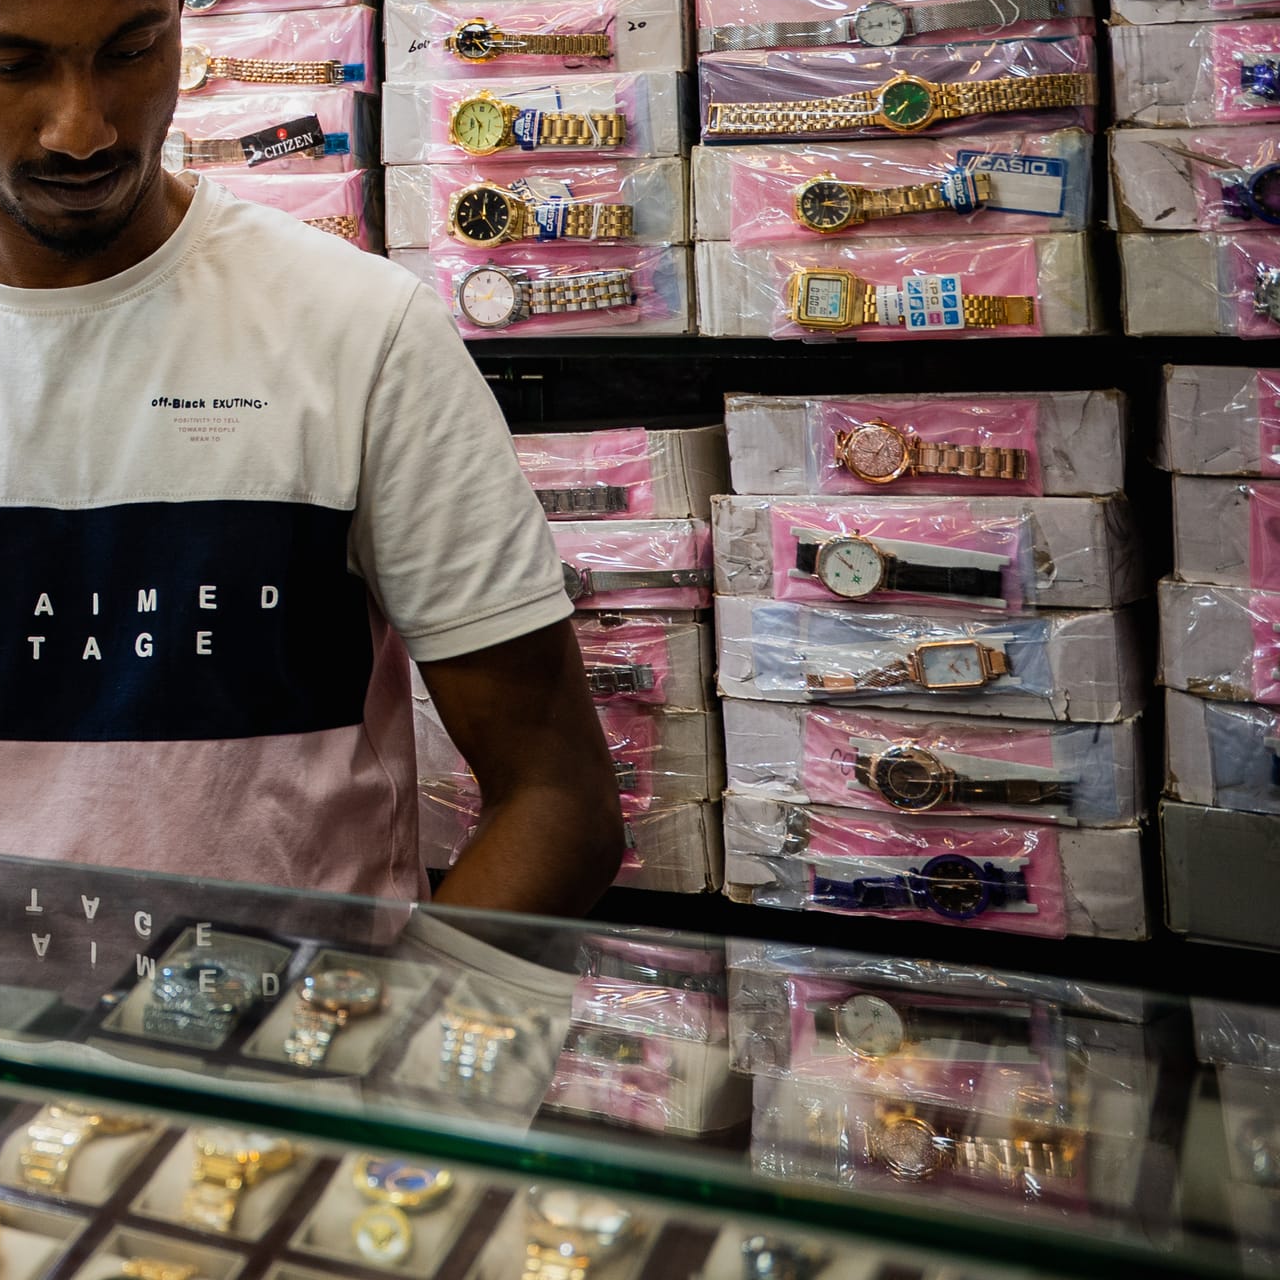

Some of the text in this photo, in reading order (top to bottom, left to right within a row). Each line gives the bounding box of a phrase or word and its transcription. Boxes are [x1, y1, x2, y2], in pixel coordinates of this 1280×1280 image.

[627, 21, 648, 32] 20
[523, 112, 532, 142] CASIO
[263, 131, 314, 160] CITIZEN
[977, 157, 1048, 175] CASIO
[954, 173, 966, 205] CASIO
